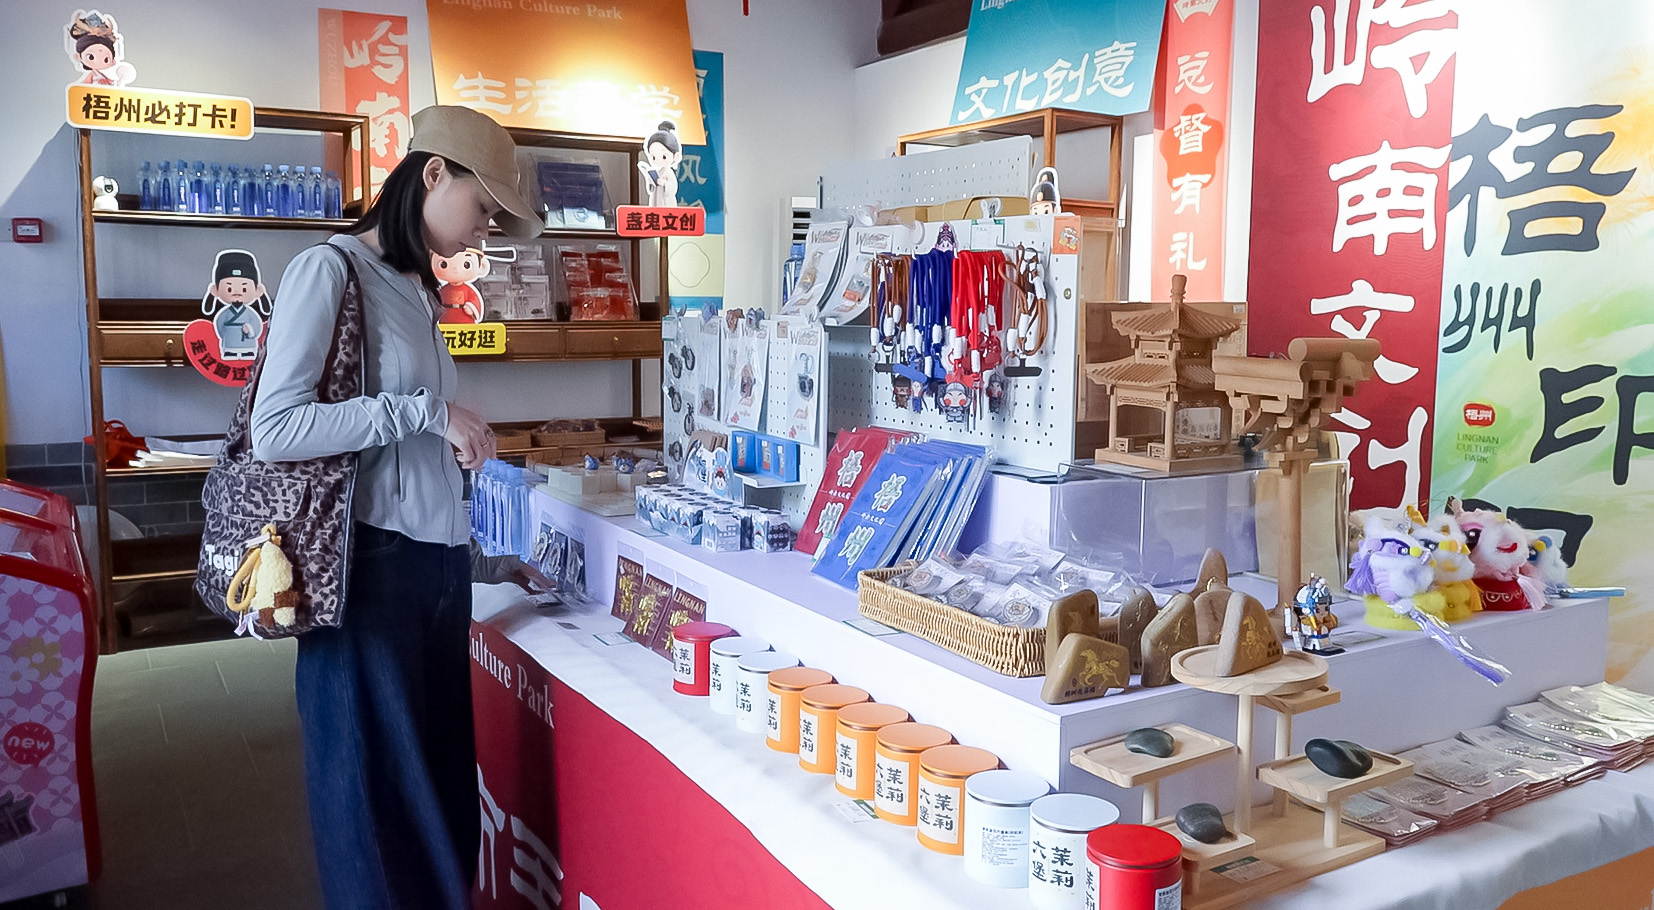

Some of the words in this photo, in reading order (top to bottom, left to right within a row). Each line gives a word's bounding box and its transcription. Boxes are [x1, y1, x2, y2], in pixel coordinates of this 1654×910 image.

[519, 0, 581, 16] Culture
[586, 4, 624, 20] Park
[452, 71, 684, 119] 生活学
[957, 40, 1138, 122] 文化创意
[82, 93, 237, 129] 梧州必打卡!
[626, 207, 696, 231] 盏鬼文创
[1456, 443, 1498, 455] CULTURE
[1457, 433, 1499, 444] LINGNAN
[1464, 453, 1489, 464] PARK
[674, 591, 705, 615] LINGNAN
[469, 632, 511, 688] ulture
[517, 663, 554, 729] Park
[7, 735, 50, 750] new
[802, 719, 814, 752] 茉莉
[839, 742, 853, 778] 茉莉
[886, 766, 904, 803] 茉莉
[932, 792, 954, 831] 茉莉
[1050, 846, 1074, 888] 茉莉
